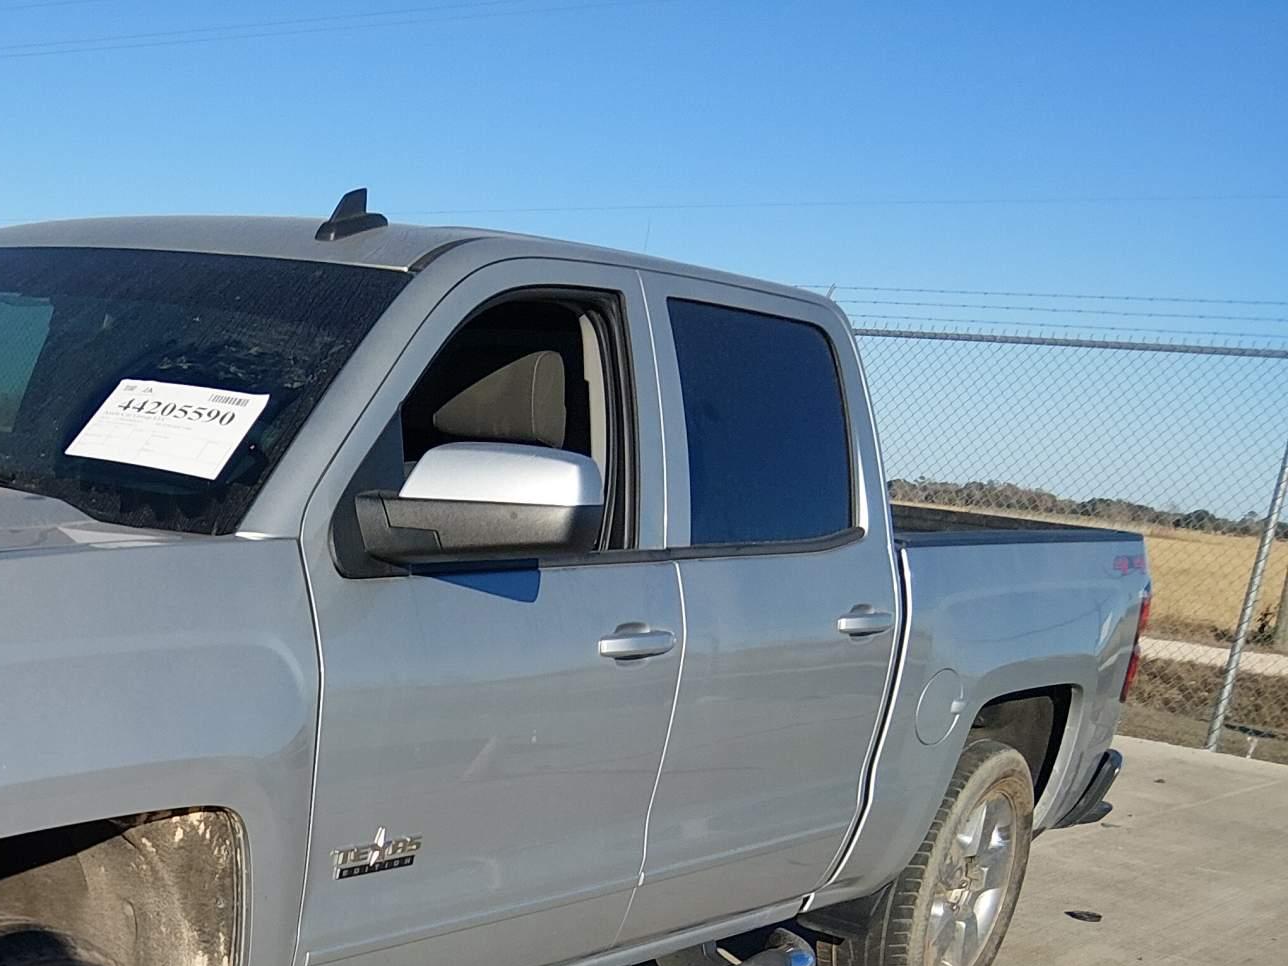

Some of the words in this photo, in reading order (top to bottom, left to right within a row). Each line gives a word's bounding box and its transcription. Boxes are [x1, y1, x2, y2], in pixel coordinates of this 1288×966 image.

[117, 398, 236, 427] 44205590
[329, 827, 423, 866] TEXAS
[340, 857, 413, 878] EDITION
